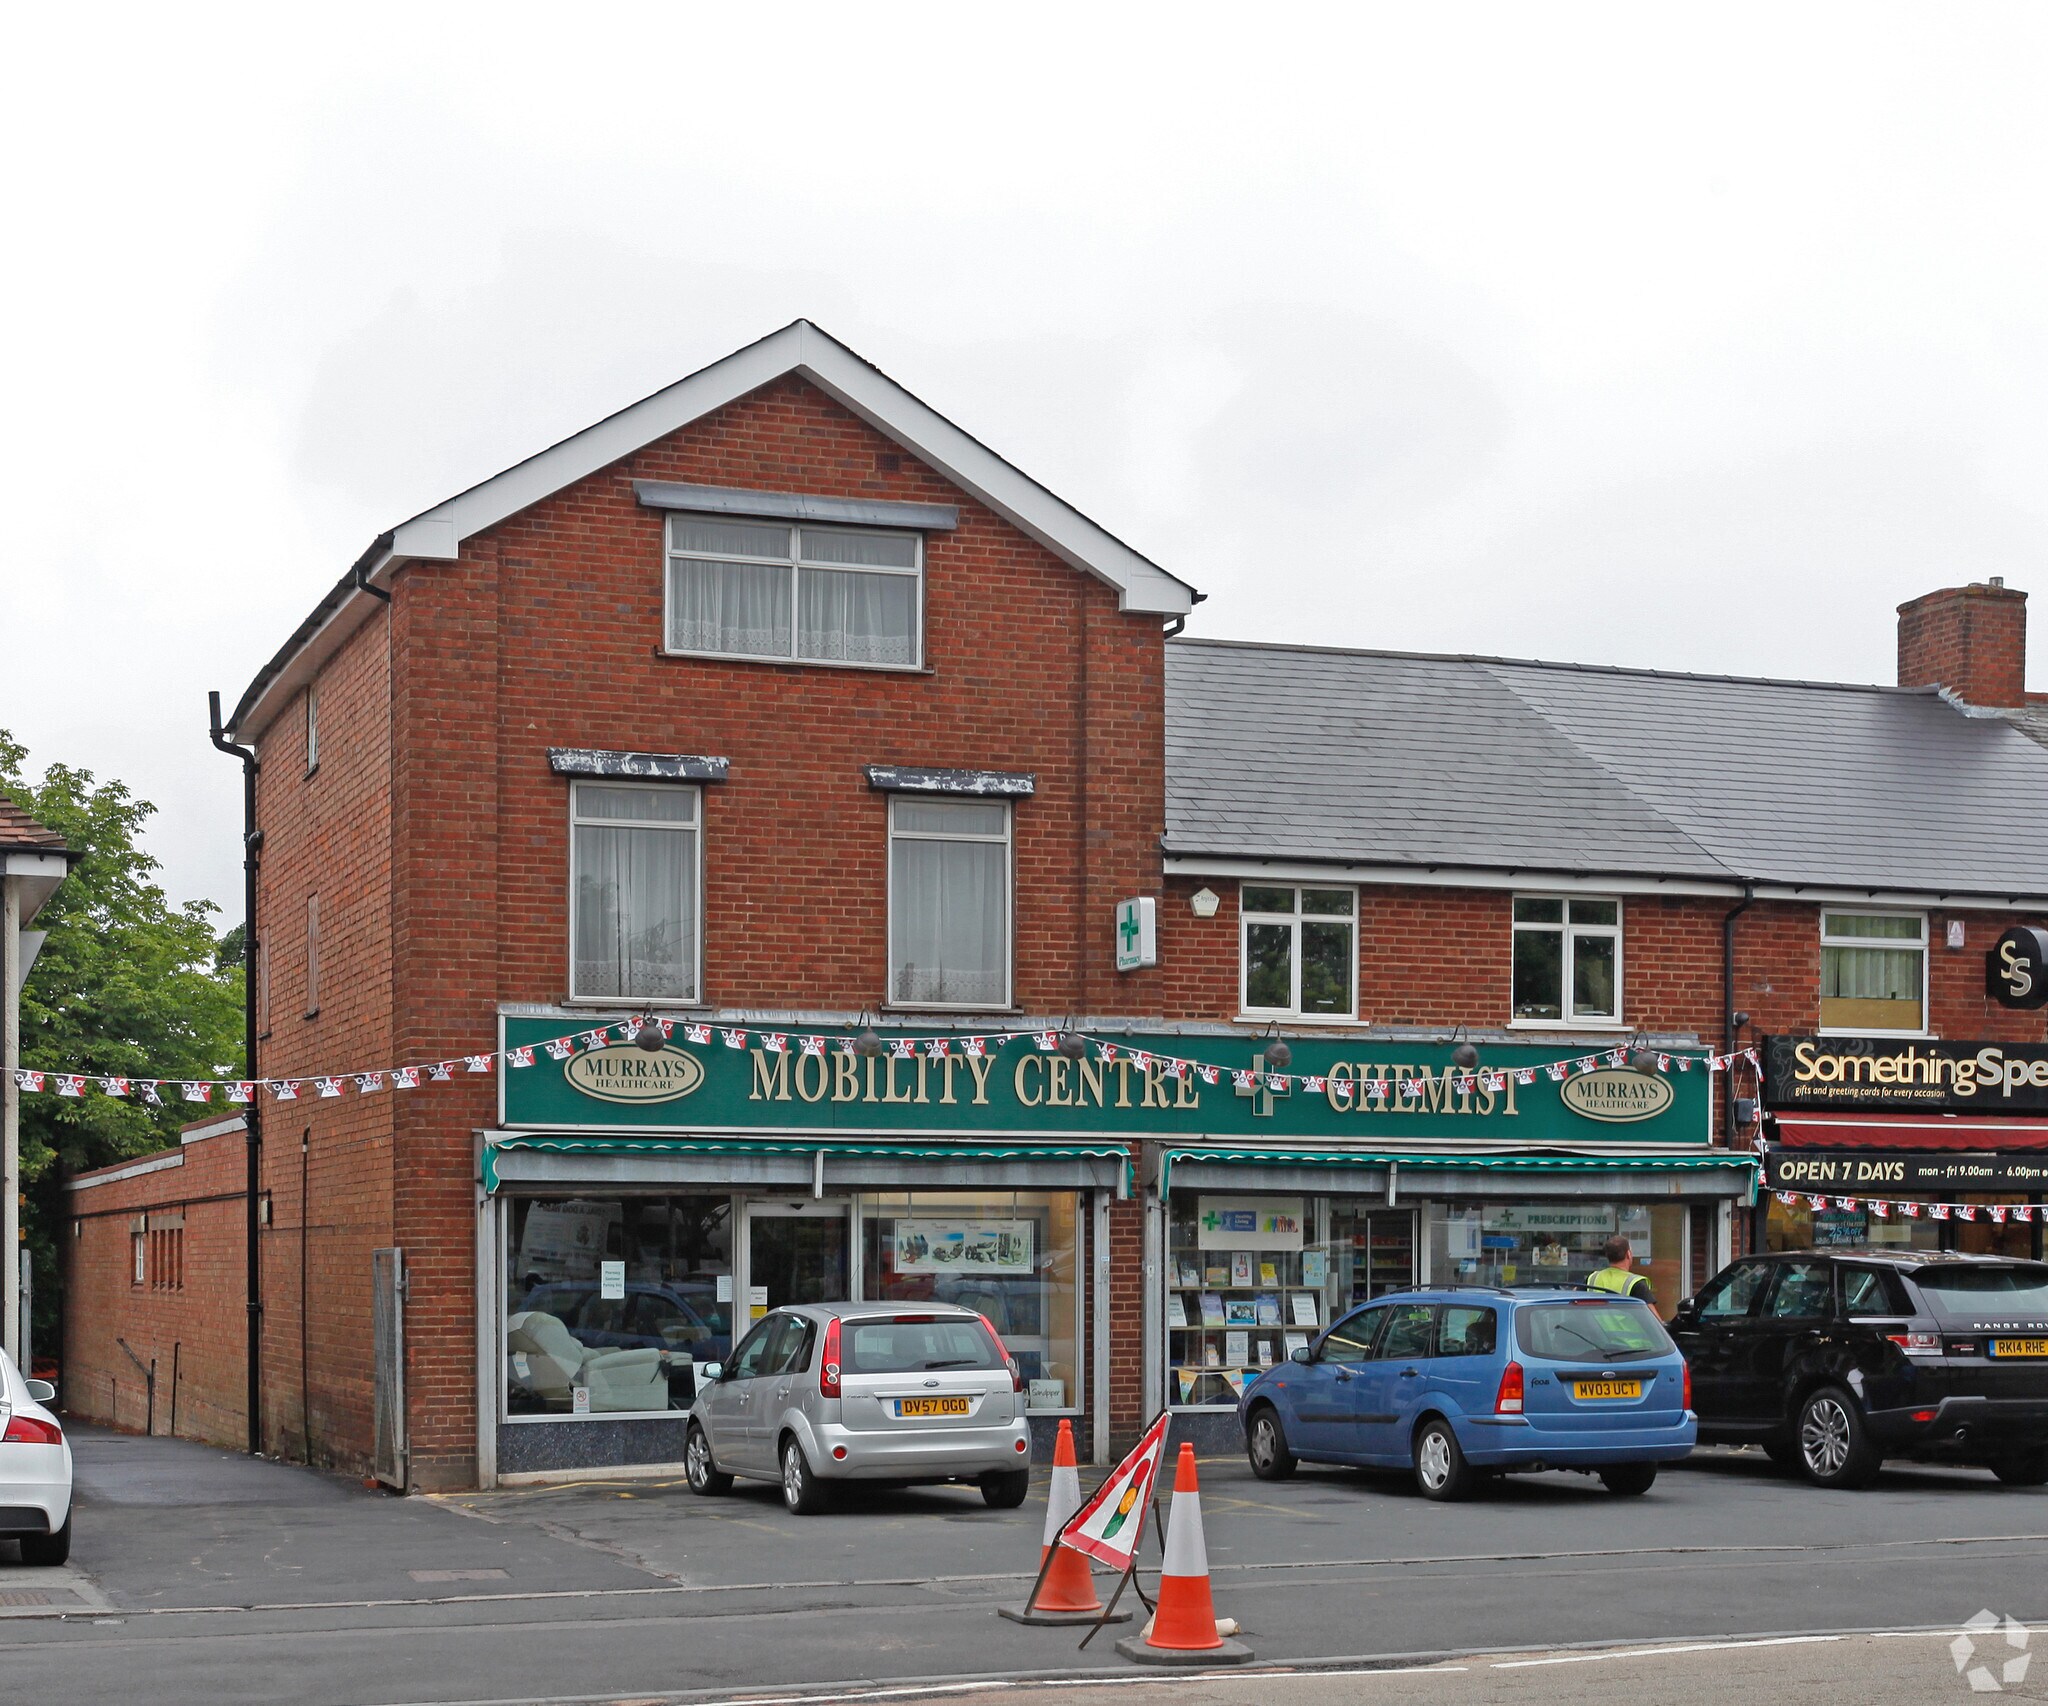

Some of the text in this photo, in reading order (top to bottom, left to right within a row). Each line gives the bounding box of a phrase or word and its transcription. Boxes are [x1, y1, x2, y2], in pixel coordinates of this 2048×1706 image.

[585, 1058, 686, 1079] MURRAYS
[595, 1078, 675, 1090] HEALTHCARE
[749, 1048, 1519, 1116] MOBILITY CENTRE CHEMIST
[1577, 1081, 1659, 1099] MURRAYS
[1795, 1084, 1946, 1099] gifts and greeting cards for every occasion
[1585, 1099, 1649, 1109] HEALTHCARE
[1779, 1161, 1905, 1181] OPEN 7 DAYS
[1918, 1167, 1939, 1176] mon
[1946, 1165, 1958, 1179] fri
[1959, 1165, 1993, 1177] 9.00am
[2006, 1166, 2040, 1179] 6.00pm
[1527, 1214, 1608, 1225] PRESCRIPTIONS
[1998, 1341, 2046, 1354] RK14 RHE
[1031, 1387, 1061, 1399] Sandpiper
[1579, 1382, 1636, 1396] MV03 UCT
[904, 1398, 967, 1414] DV57 OGO
